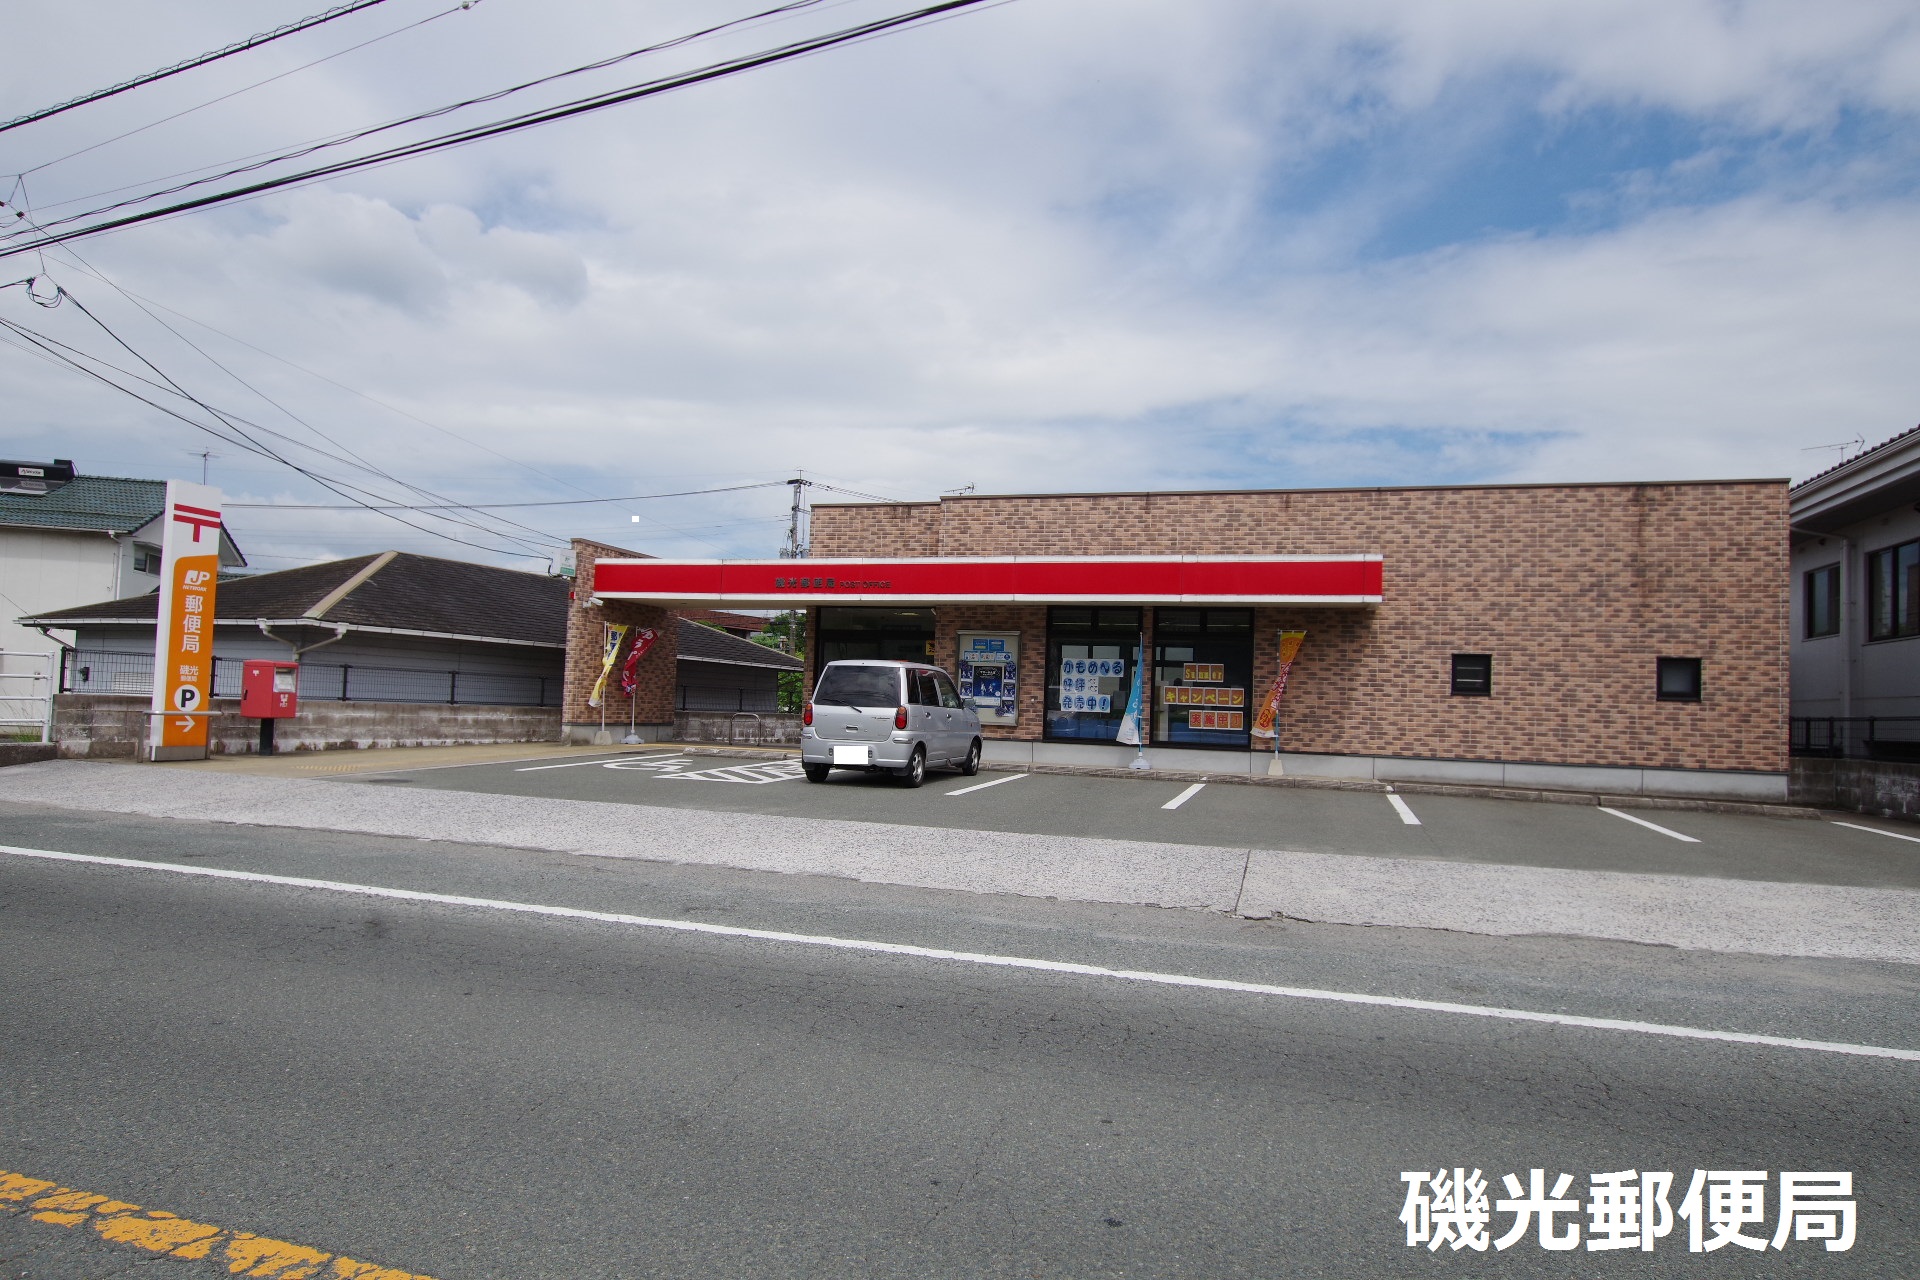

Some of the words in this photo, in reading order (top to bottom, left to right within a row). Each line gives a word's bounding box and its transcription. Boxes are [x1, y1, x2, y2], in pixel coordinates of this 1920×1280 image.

[839, 581, 861, 589] POST
[863, 581, 892, 589] OFFICE
[181, 595, 204, 654] 郵便局
[1185, 668, 1223, 680] Summer
[181, 689, 195, 708] P
[1063, 696, 1107, 710] 発売中！
[1166, 691, 1243, 704] キャンペーン
